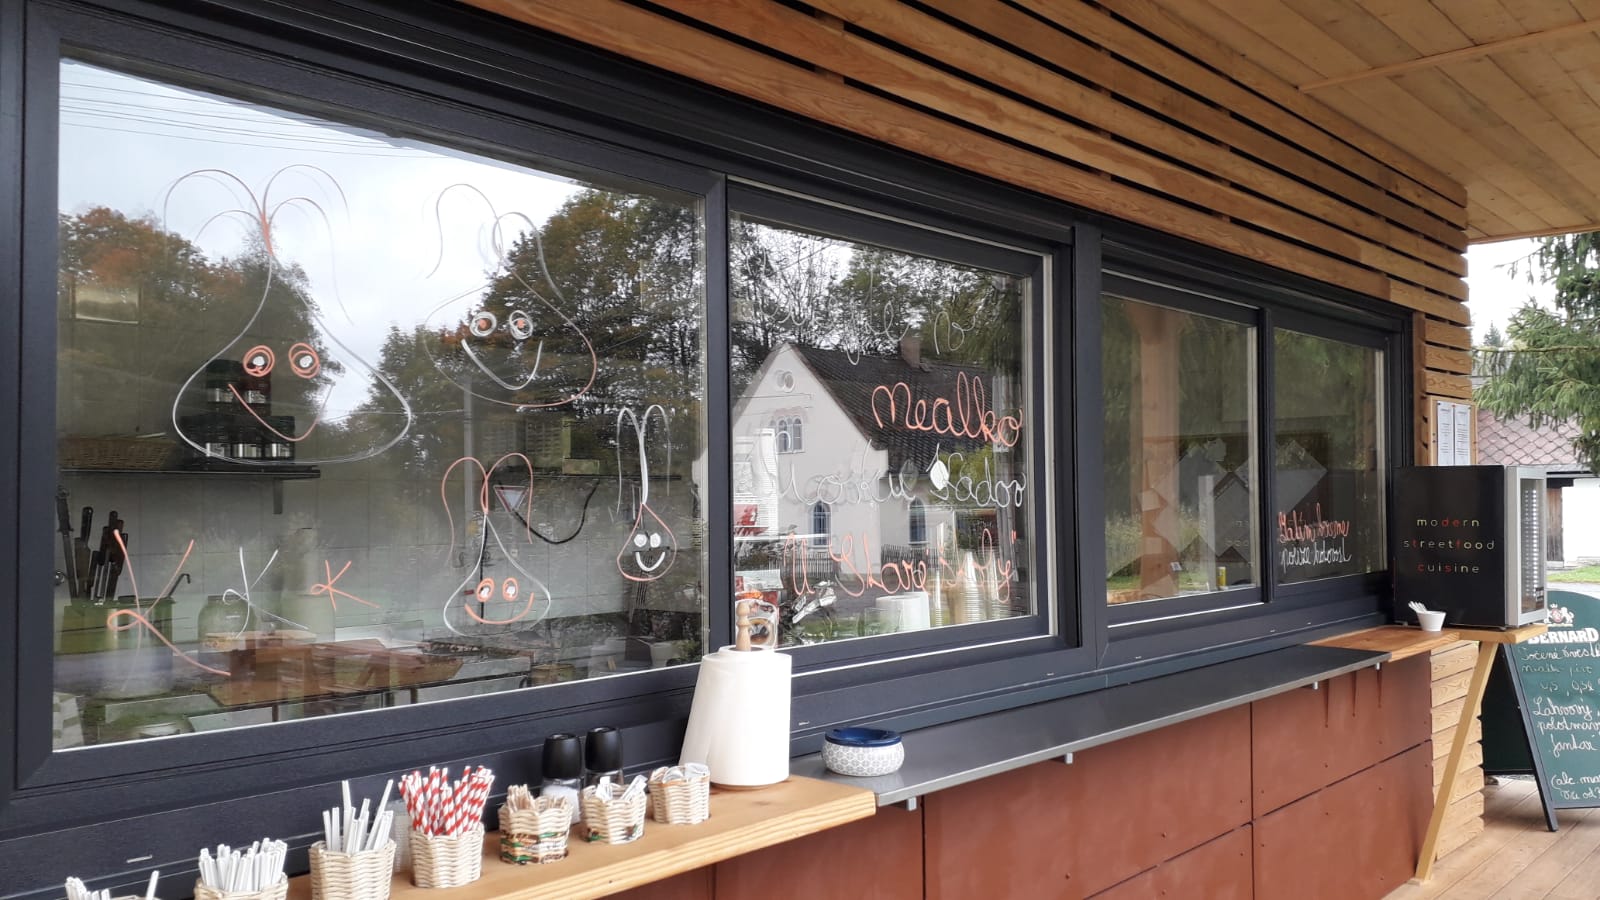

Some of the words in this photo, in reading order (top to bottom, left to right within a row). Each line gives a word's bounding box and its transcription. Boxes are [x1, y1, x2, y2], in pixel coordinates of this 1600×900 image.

[1416, 517, 1480, 527] modern
[1403, 539, 1495, 550] streetfood
[1417, 563, 1480, 574] cuisine
